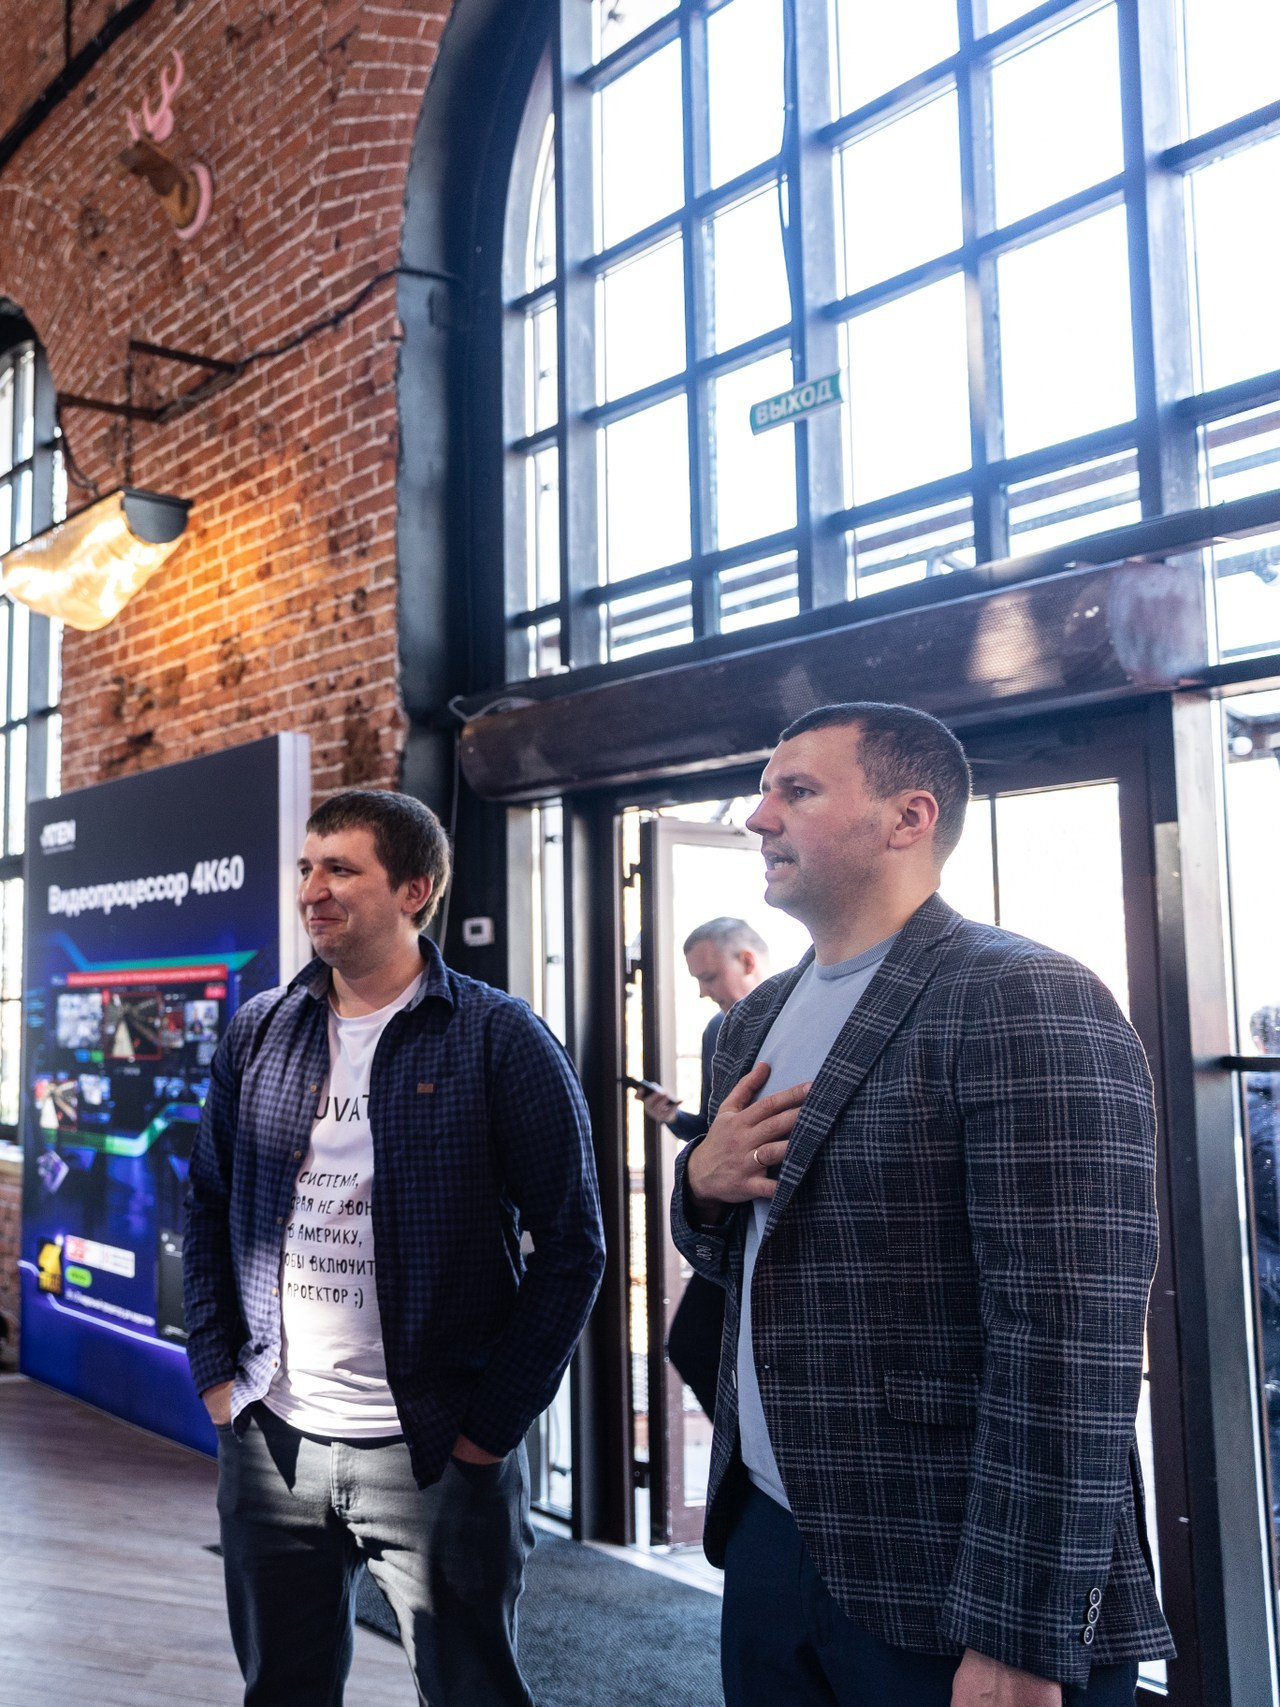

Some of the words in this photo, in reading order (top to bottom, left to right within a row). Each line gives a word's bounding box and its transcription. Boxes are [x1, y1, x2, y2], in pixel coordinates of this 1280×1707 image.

[755, 379, 834, 426] ВЫХОД
[48, 871, 189, 917] Видеопроцессор
[190, 854, 245, 895] 4K60
[299, 1171, 360, 1190] СИСТЕМА,
[318, 1199, 336, 1215] НЕ
[297, 1223, 362, 1248] АМЕРИКУ,
[287, 1282, 349, 1303] ПРОЕКТОР
